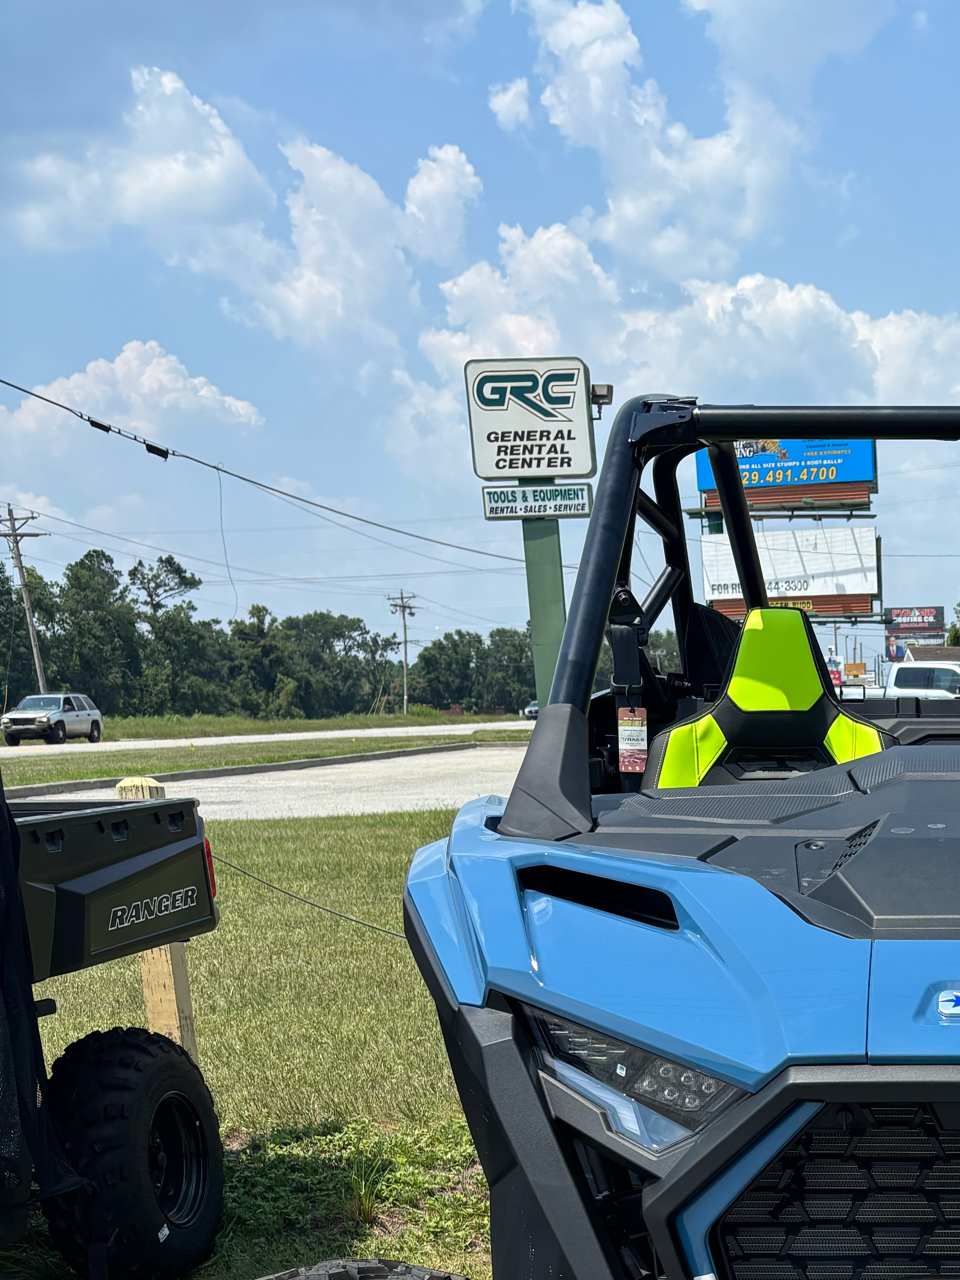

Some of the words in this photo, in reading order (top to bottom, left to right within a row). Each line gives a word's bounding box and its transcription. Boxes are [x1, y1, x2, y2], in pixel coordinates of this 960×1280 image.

[473, 369, 579, 421] GRC
[487, 430, 576, 442] GENERAL
[497, 444, 569, 456] RENTAL
[495, 457, 572, 469] CENTER
[742, 466, 837, 485] 29.491.4700
[486, 490, 517, 504] TOOLS
[521, 490, 528, 502] &
[532, 487, 585, 502] EQUIPMENT
[489, 505, 518, 515] RENTAL
[523, 504, 547, 513] SALES
[553, 502, 586, 512] SERVICE
[711, 583, 729, 595] FOR
[108, 886, 197, 931] RANGER
